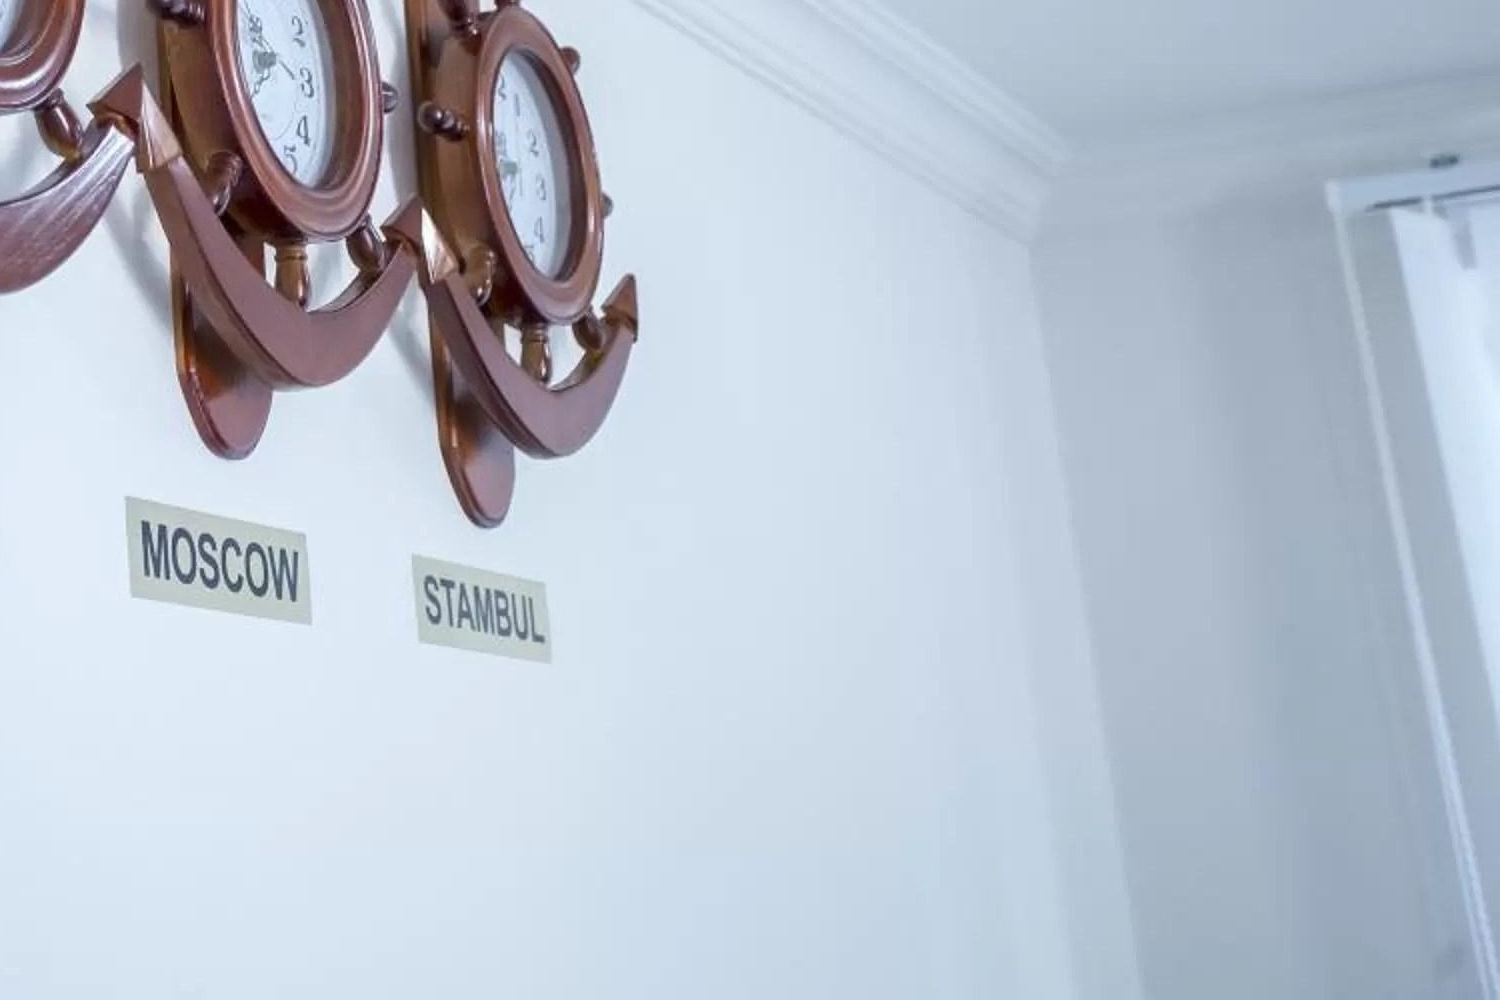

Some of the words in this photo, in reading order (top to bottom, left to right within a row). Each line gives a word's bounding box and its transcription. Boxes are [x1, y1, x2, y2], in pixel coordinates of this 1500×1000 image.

[292, 15, 306, 48] 2
[300, 67, 314, 99] 3
[296, 115, 311, 146] 4
[140, 519, 299, 602] MOSCOW
[424, 575, 546, 644] STAMBUL
